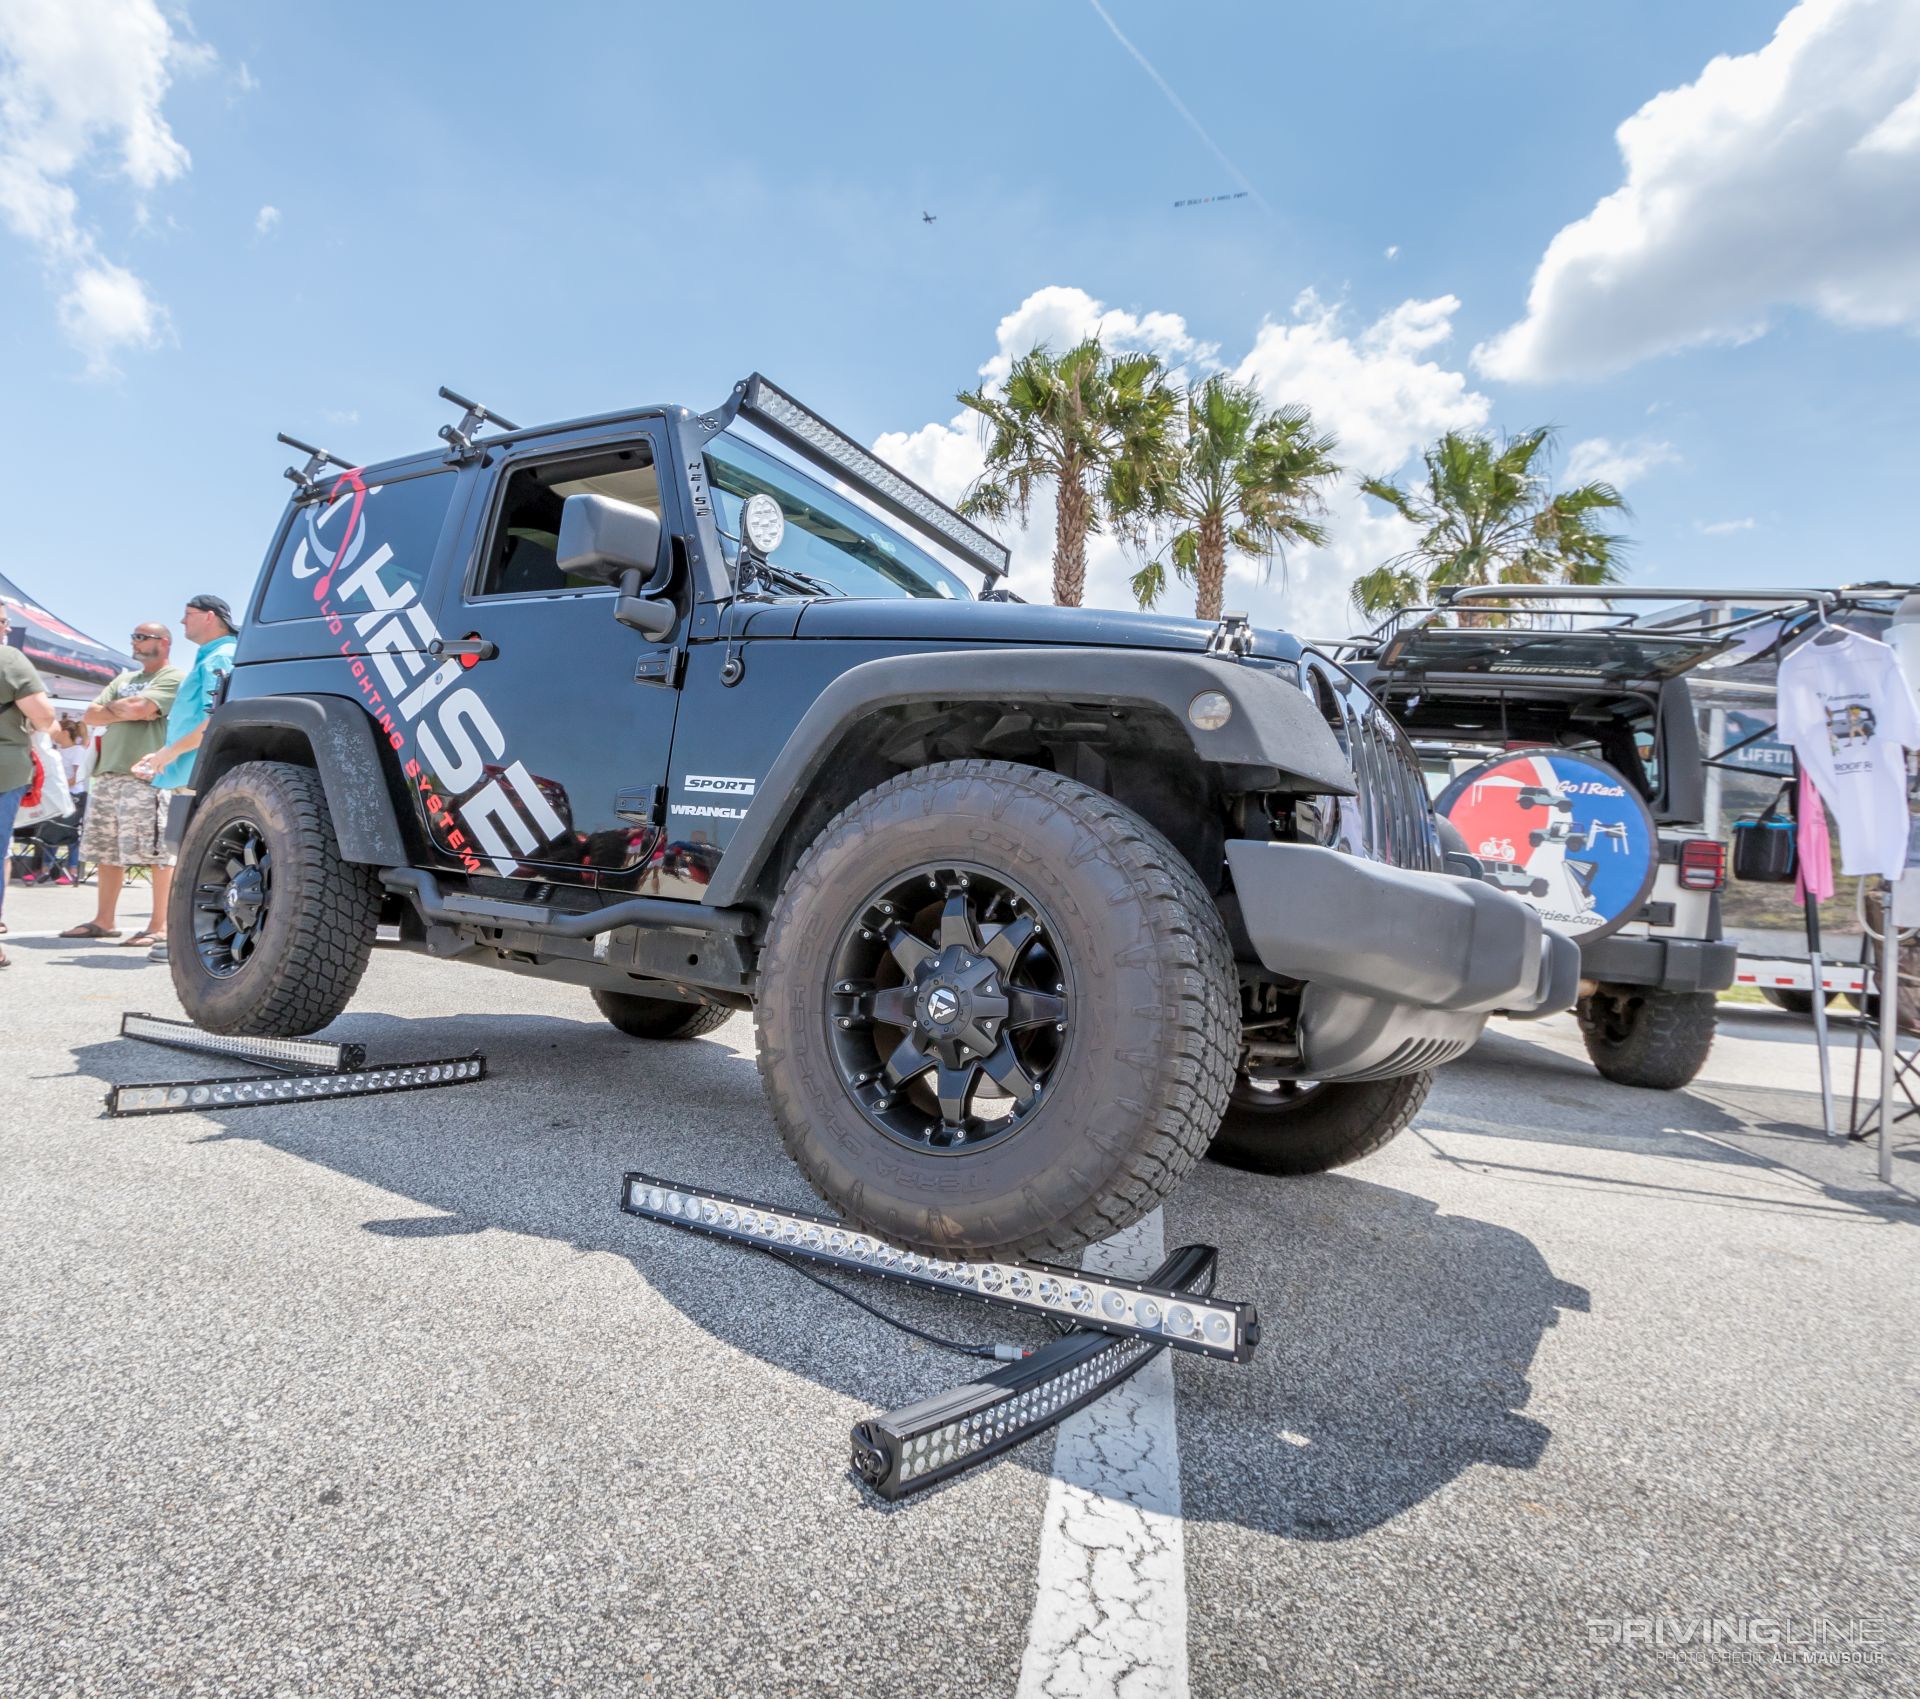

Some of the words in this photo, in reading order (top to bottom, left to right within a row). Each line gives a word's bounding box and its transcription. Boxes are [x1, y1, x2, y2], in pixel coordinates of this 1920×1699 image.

[688, 462, 712, 517] HEISE
[337, 542, 566, 878] HEISE
[340, 640, 405, 750] LIGHTING
[686, 778, 755, 792] SPORT
